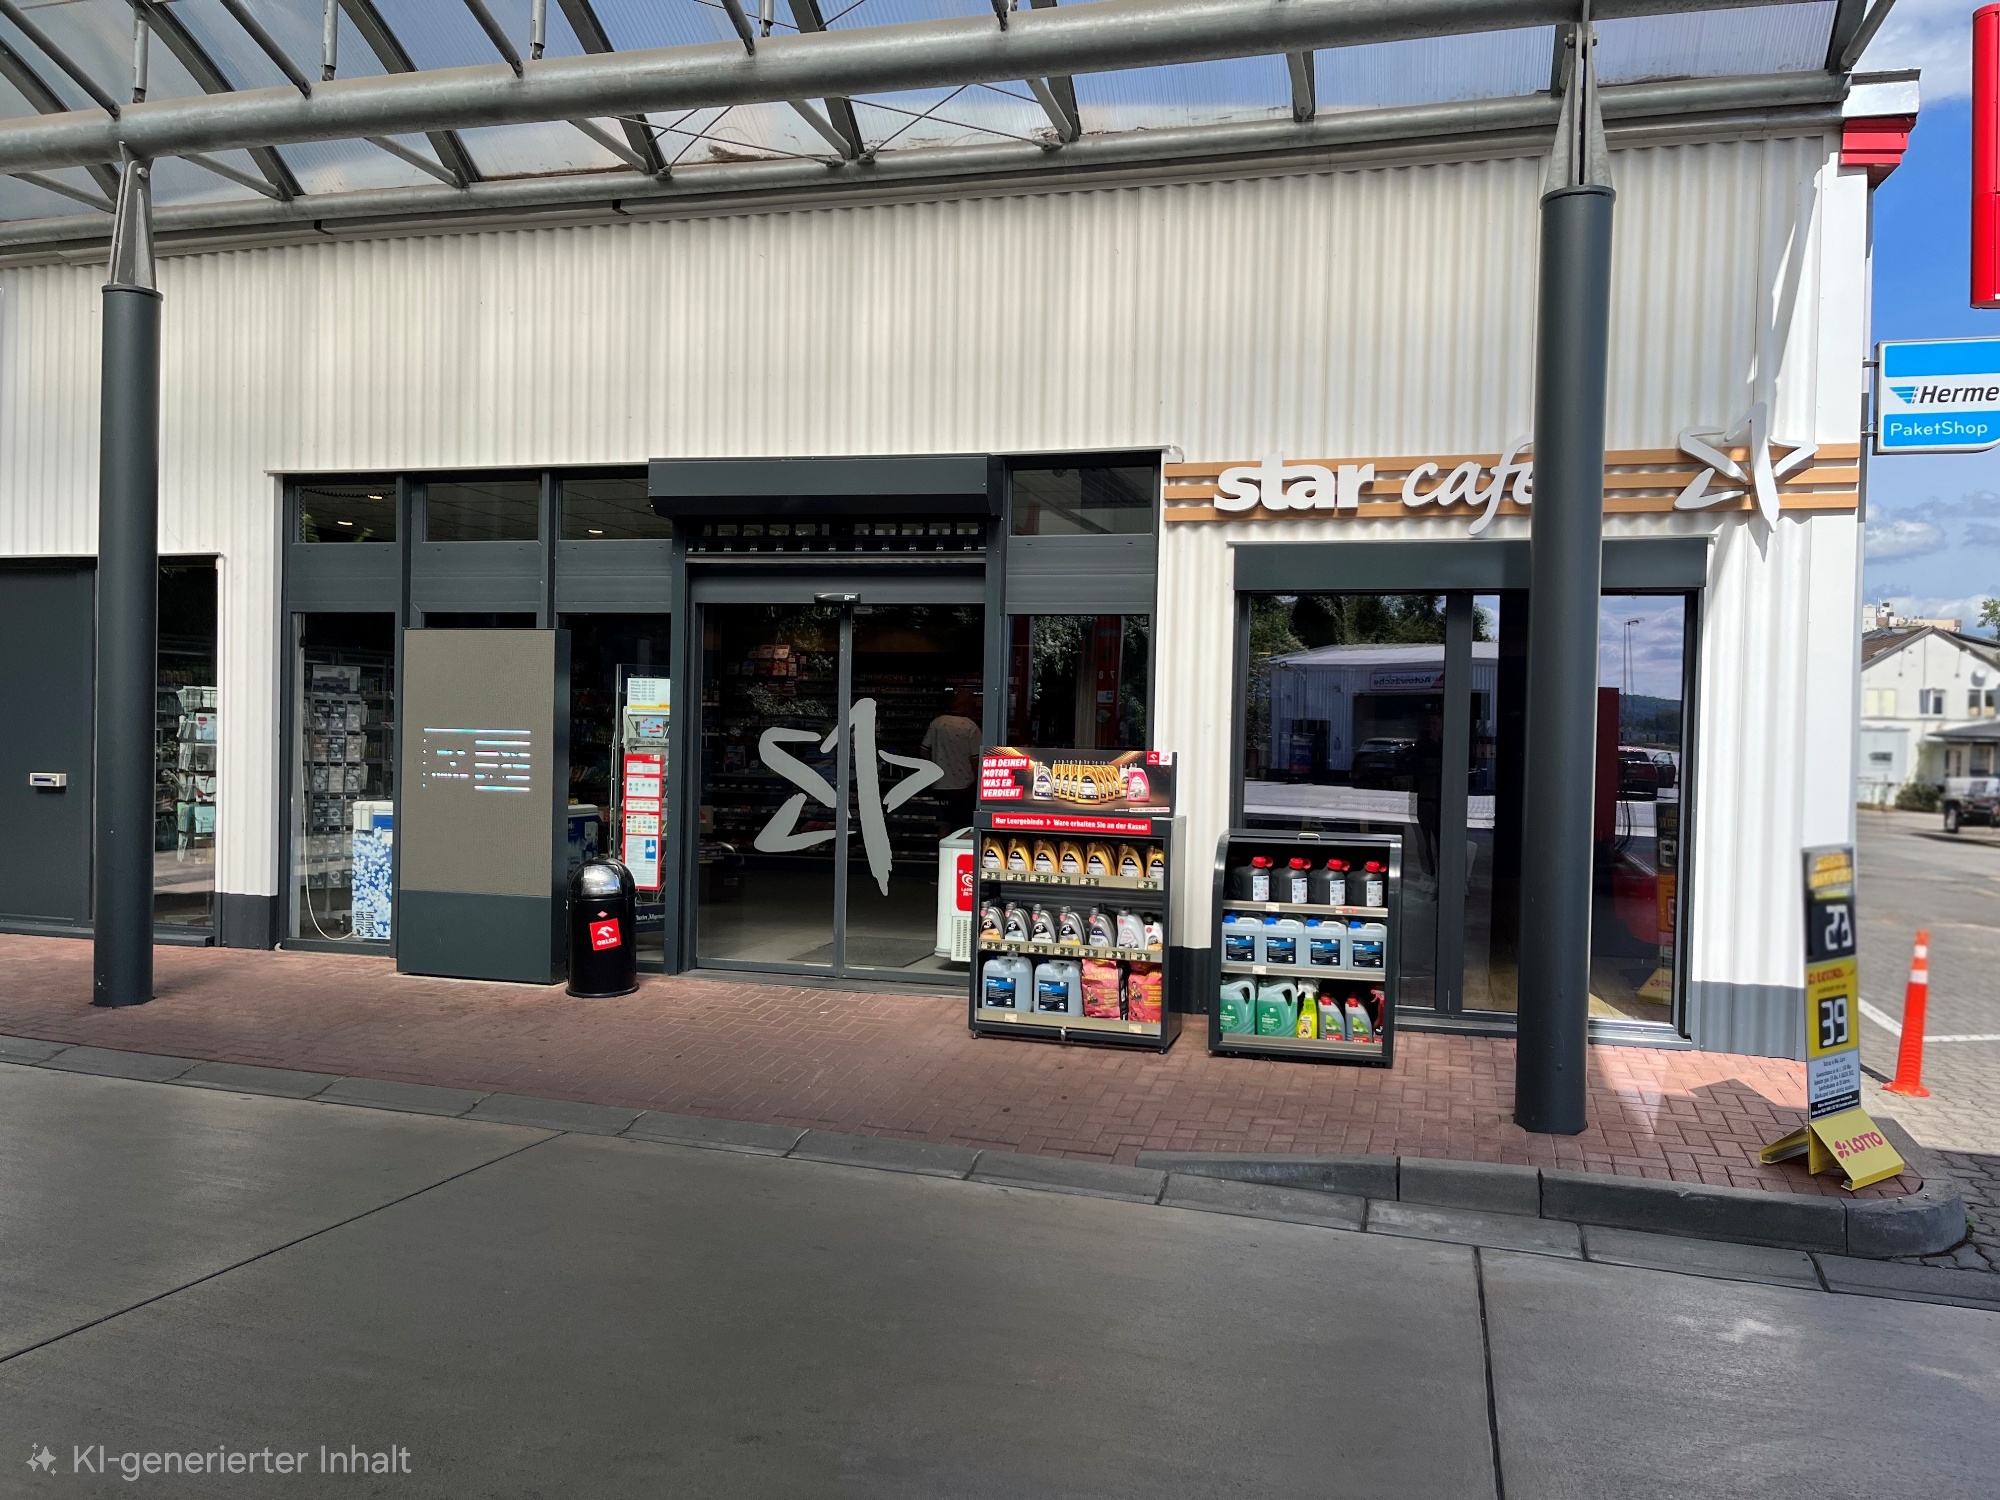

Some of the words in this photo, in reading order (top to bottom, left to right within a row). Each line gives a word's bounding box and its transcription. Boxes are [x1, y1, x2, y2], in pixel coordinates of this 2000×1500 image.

[1918, 385, 2000, 404] Herme
[1890, 421, 1988, 437] PaketShop
[1213, 450, 1375, 512] star
[983, 758, 997, 767] GIB
[997, 758, 1027, 767] DEINEM
[982, 769, 1009, 777] MOTOR
[983, 778, 1000, 787] WAS
[1001, 778, 1012, 787] ER
[982, 788, 1020, 797] VERDIENT
[995, 817, 1006, 826] Nur
[1006, 817, 1044, 827] Leergebinde
[1053, 819, 1069, 827] Ware
[1069, 819, 1096, 828] erhalten
[1096, 821, 1106, 829] Sie
[1115, 821, 1127, 830] der
[596, 937, 617, 946] ORLEN
[1820, 997, 1849, 1047] 39
[1846, 1131, 1884, 1154] LOTTO
